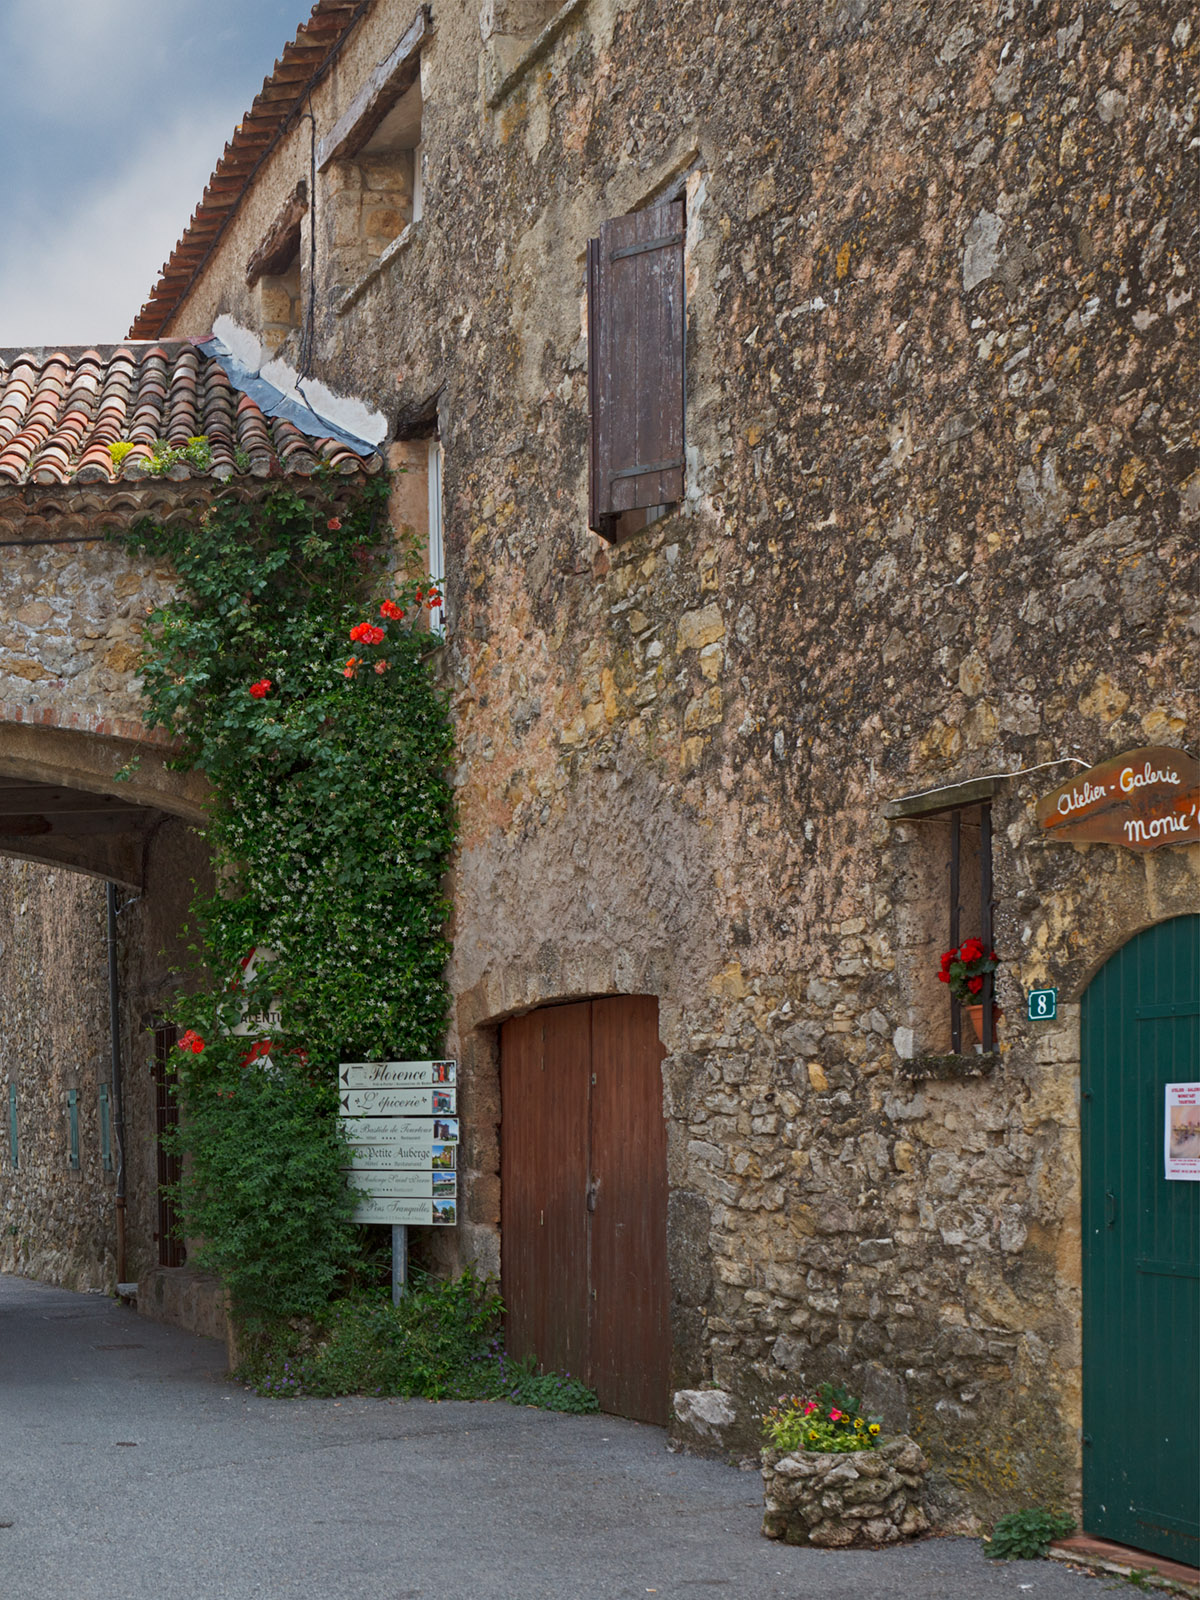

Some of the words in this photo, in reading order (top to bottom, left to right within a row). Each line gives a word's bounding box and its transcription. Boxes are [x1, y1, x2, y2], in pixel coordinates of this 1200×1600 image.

[1119, 761, 1181, 792] Galerie
[1123, 803, 1200, 842] Monic'
[1037, 994, 1047, 1015] 8
[368, 1064, 427, 1081] Florence
[360, 1123, 389, 1133] Bastide
[389, 1124, 398, 1133] de
[366, 1147, 392, 1160] Petite
[393, 1146, 430, 1160] Auberge
[386, 1199, 430, 1216] Tranquilles
